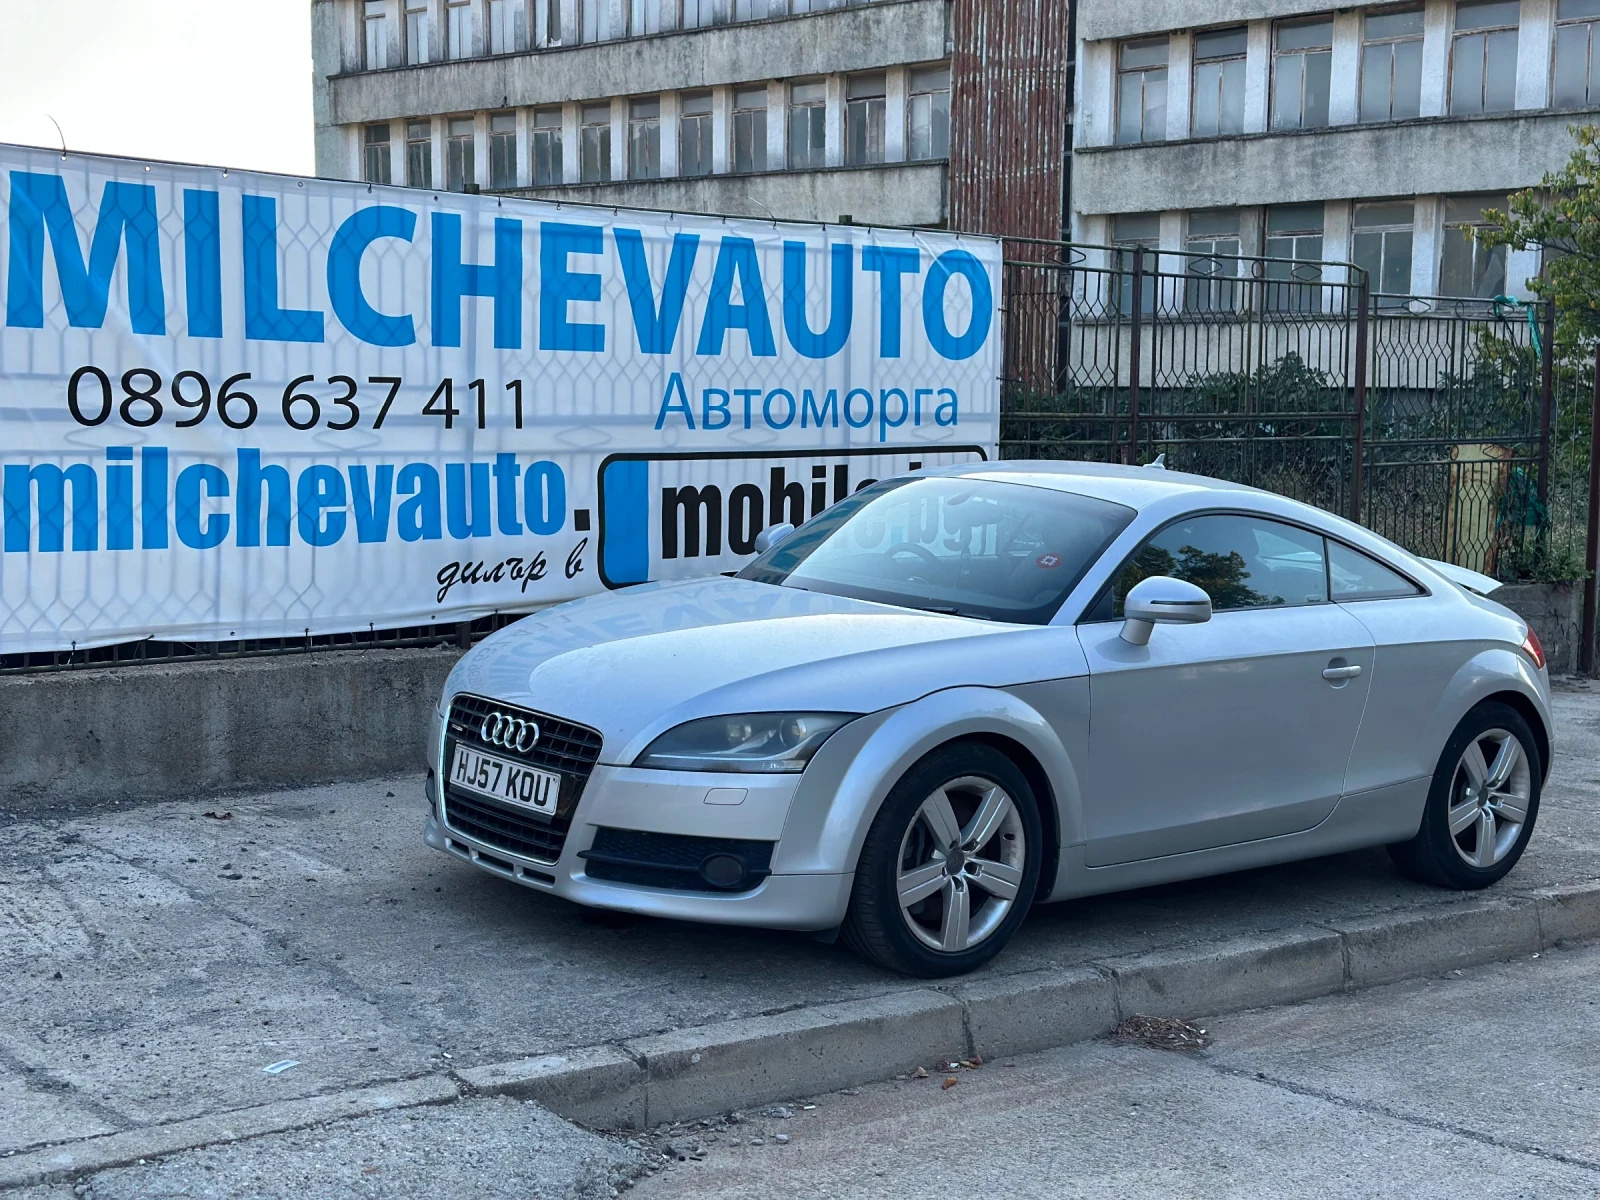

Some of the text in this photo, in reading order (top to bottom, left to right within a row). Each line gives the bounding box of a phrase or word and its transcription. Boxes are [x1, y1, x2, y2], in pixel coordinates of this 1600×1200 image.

[6, 171, 993, 360] MILCHEVAUTO
[68, 366, 523, 430] 0896 637 411
[654, 372, 956, 442] Автоморга
[437, 537, 588, 603] дилър в
[456, 751, 551, 807] HJ57 KOU
